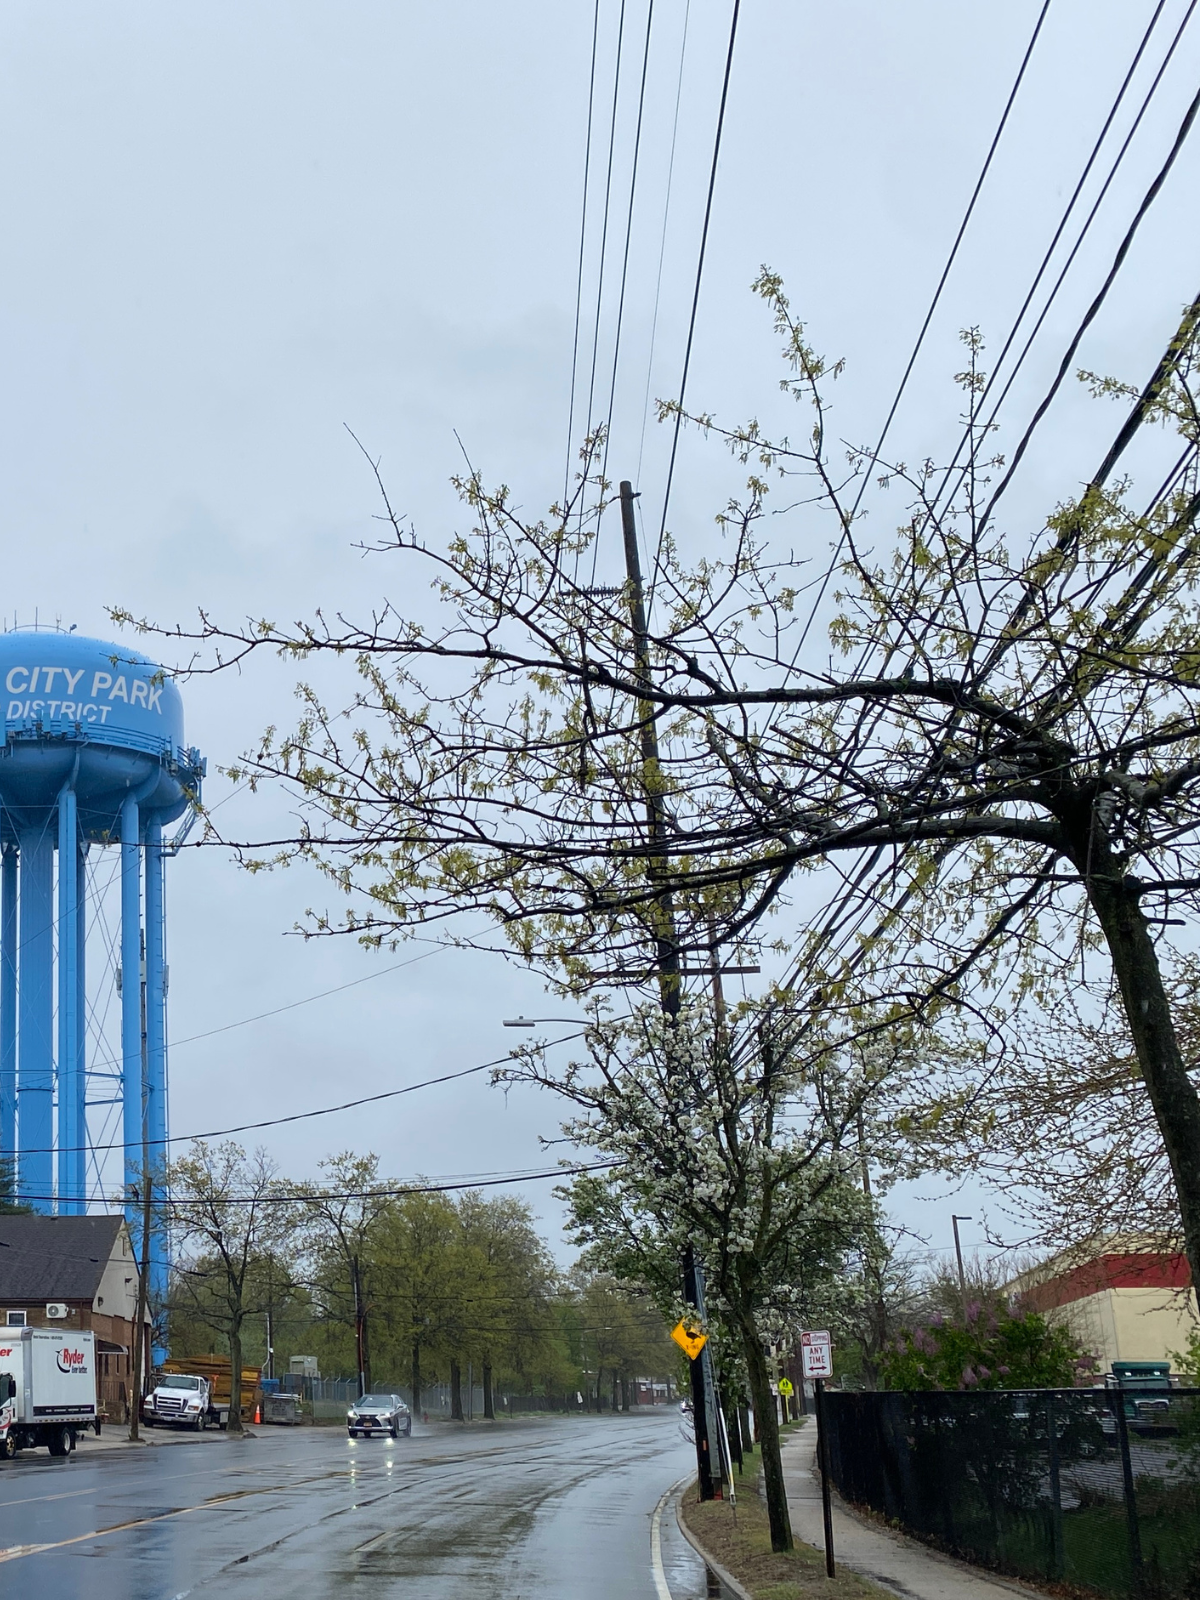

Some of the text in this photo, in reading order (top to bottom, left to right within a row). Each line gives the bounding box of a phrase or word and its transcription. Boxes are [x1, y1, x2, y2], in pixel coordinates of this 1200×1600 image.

[5, 666, 85, 695] CITY
[90, 671, 164, 715] PARK
[6, 699, 112, 724] DISTRICT
[63, 1348, 84, 1368] Ryder
[809, 1346, 823, 1355] ANY
[809, 1356, 825, 1364] TIME
